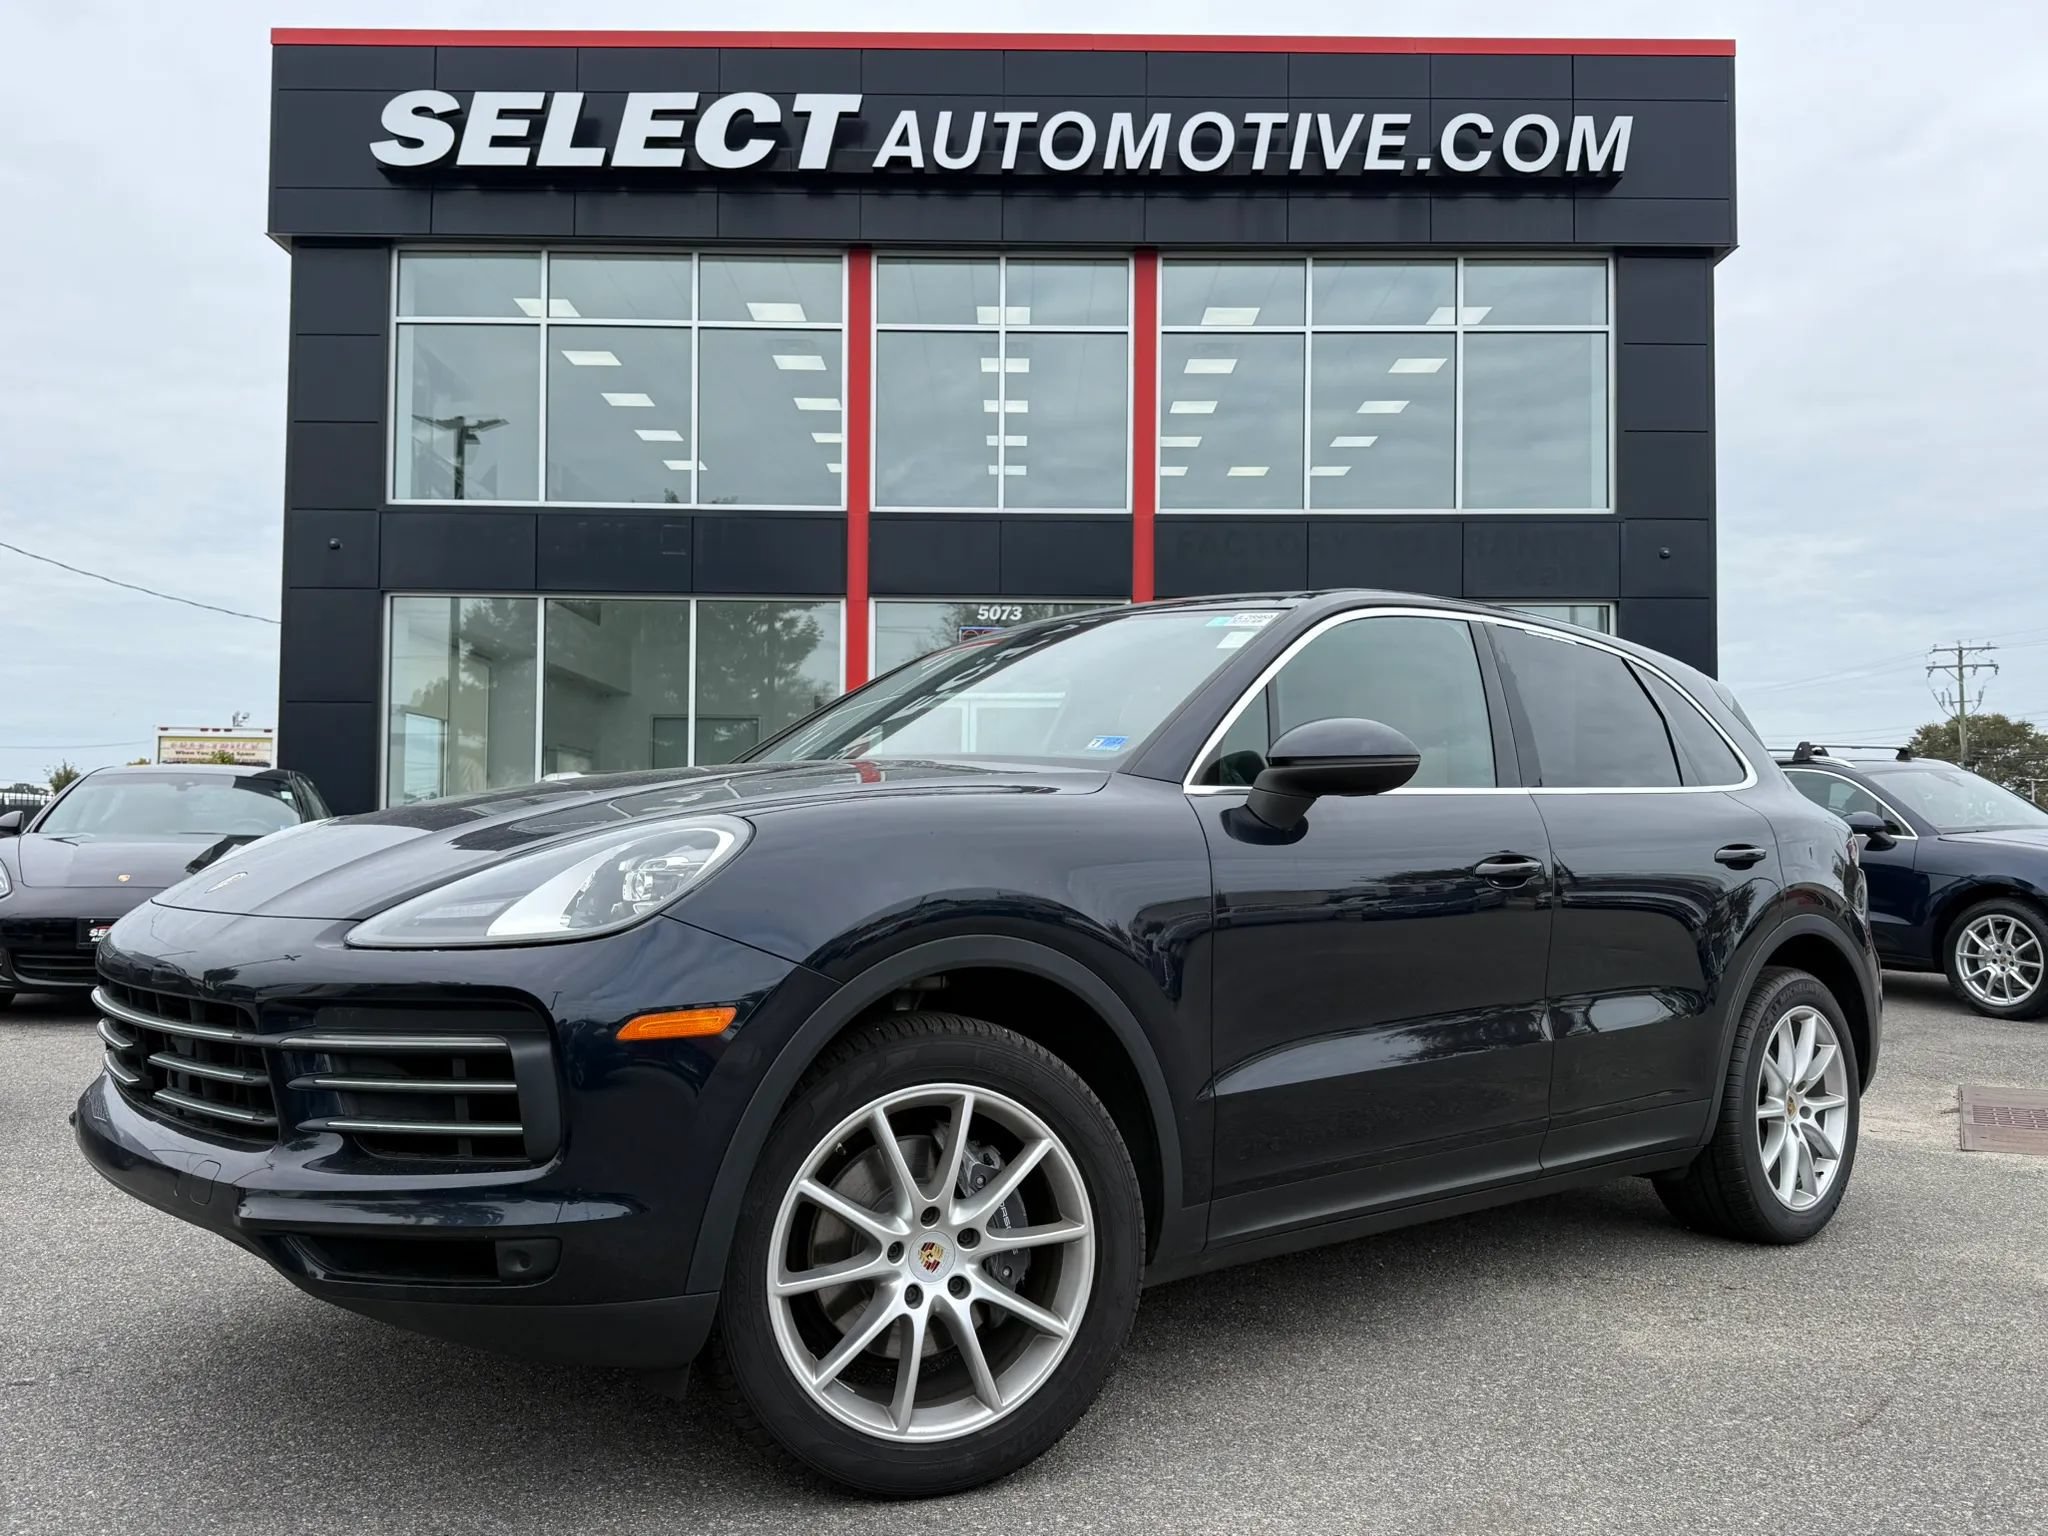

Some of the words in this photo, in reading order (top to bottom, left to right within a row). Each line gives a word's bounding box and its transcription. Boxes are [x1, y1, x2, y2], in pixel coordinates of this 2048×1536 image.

[369, 89, 863, 170] SELECT
[872, 110, 1634, 174] AUTOMOTIVE.COM
[977, 605, 1023, 621] 5073
